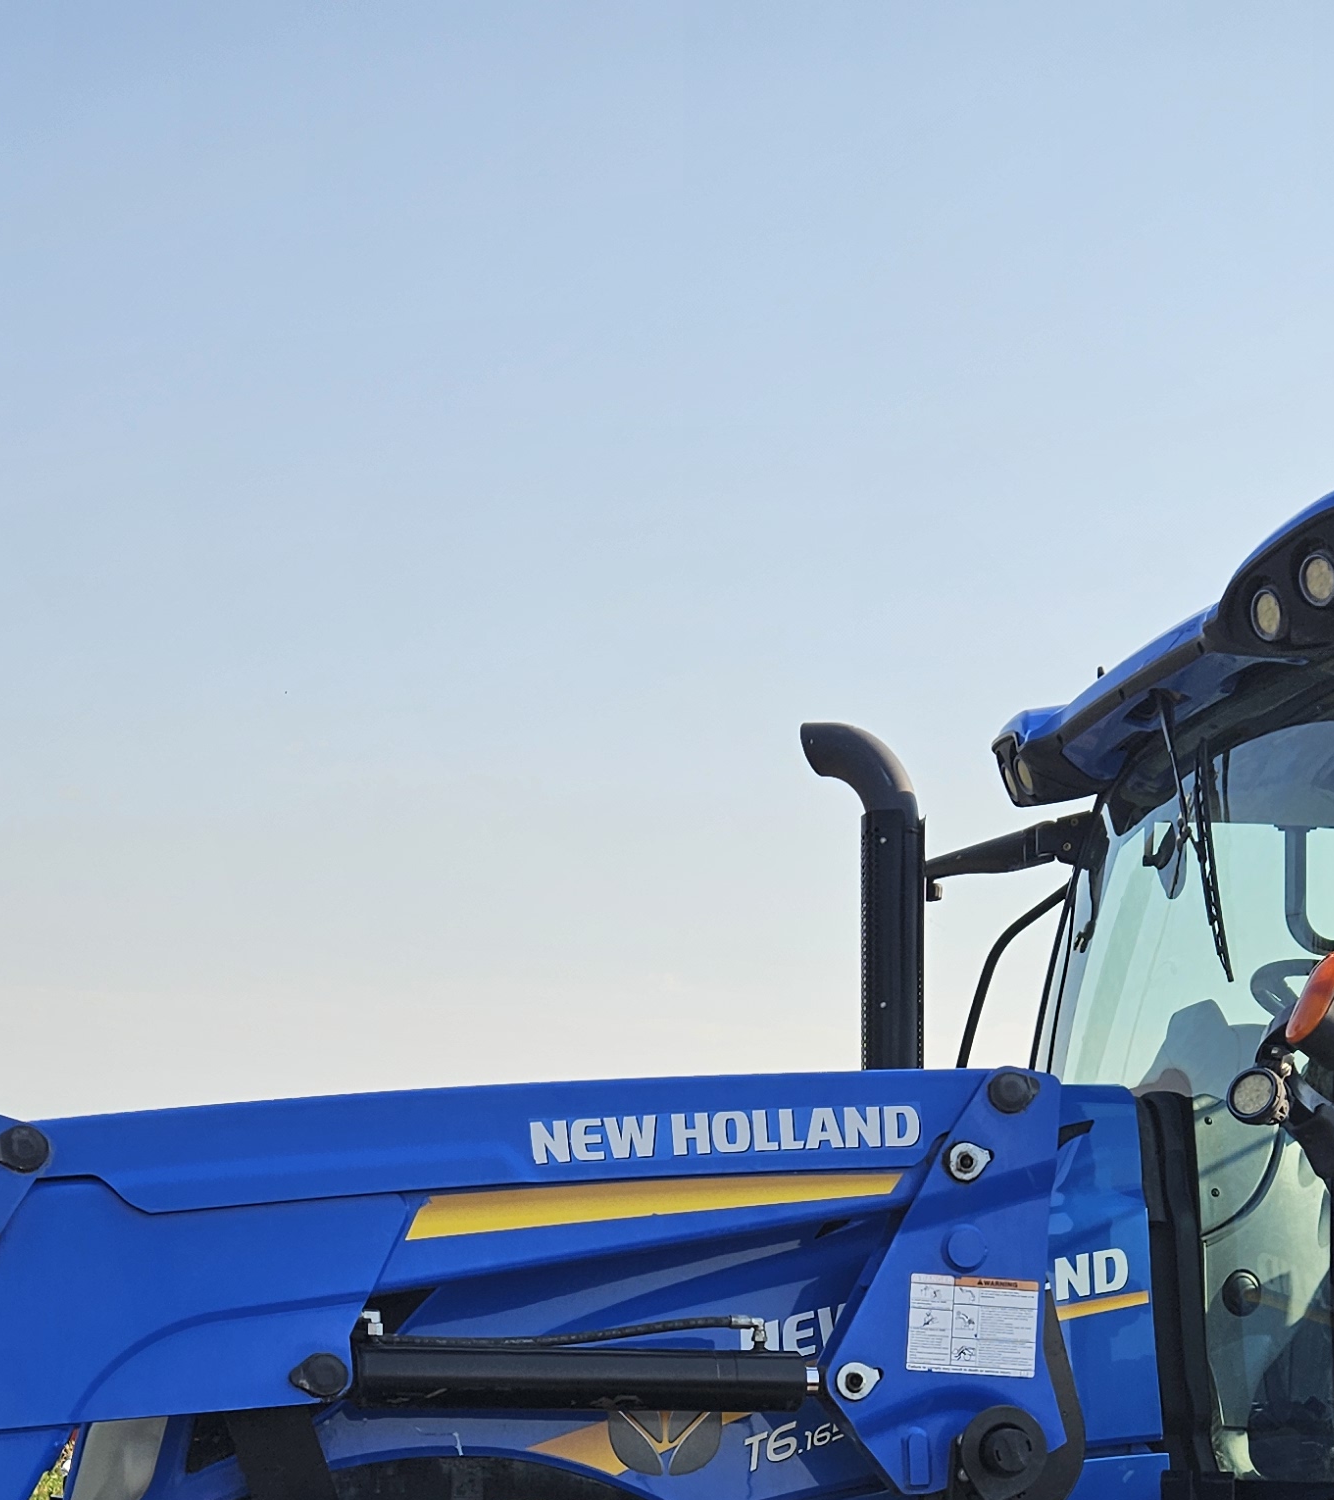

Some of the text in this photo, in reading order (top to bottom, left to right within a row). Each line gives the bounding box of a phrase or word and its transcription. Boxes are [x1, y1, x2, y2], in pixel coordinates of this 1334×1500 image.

[529, 1105, 921, 1165] NEW HOLLAND
[984, 1279, 1018, 1289] WARNING
[1053, 1247, 1129, 1302] ND
